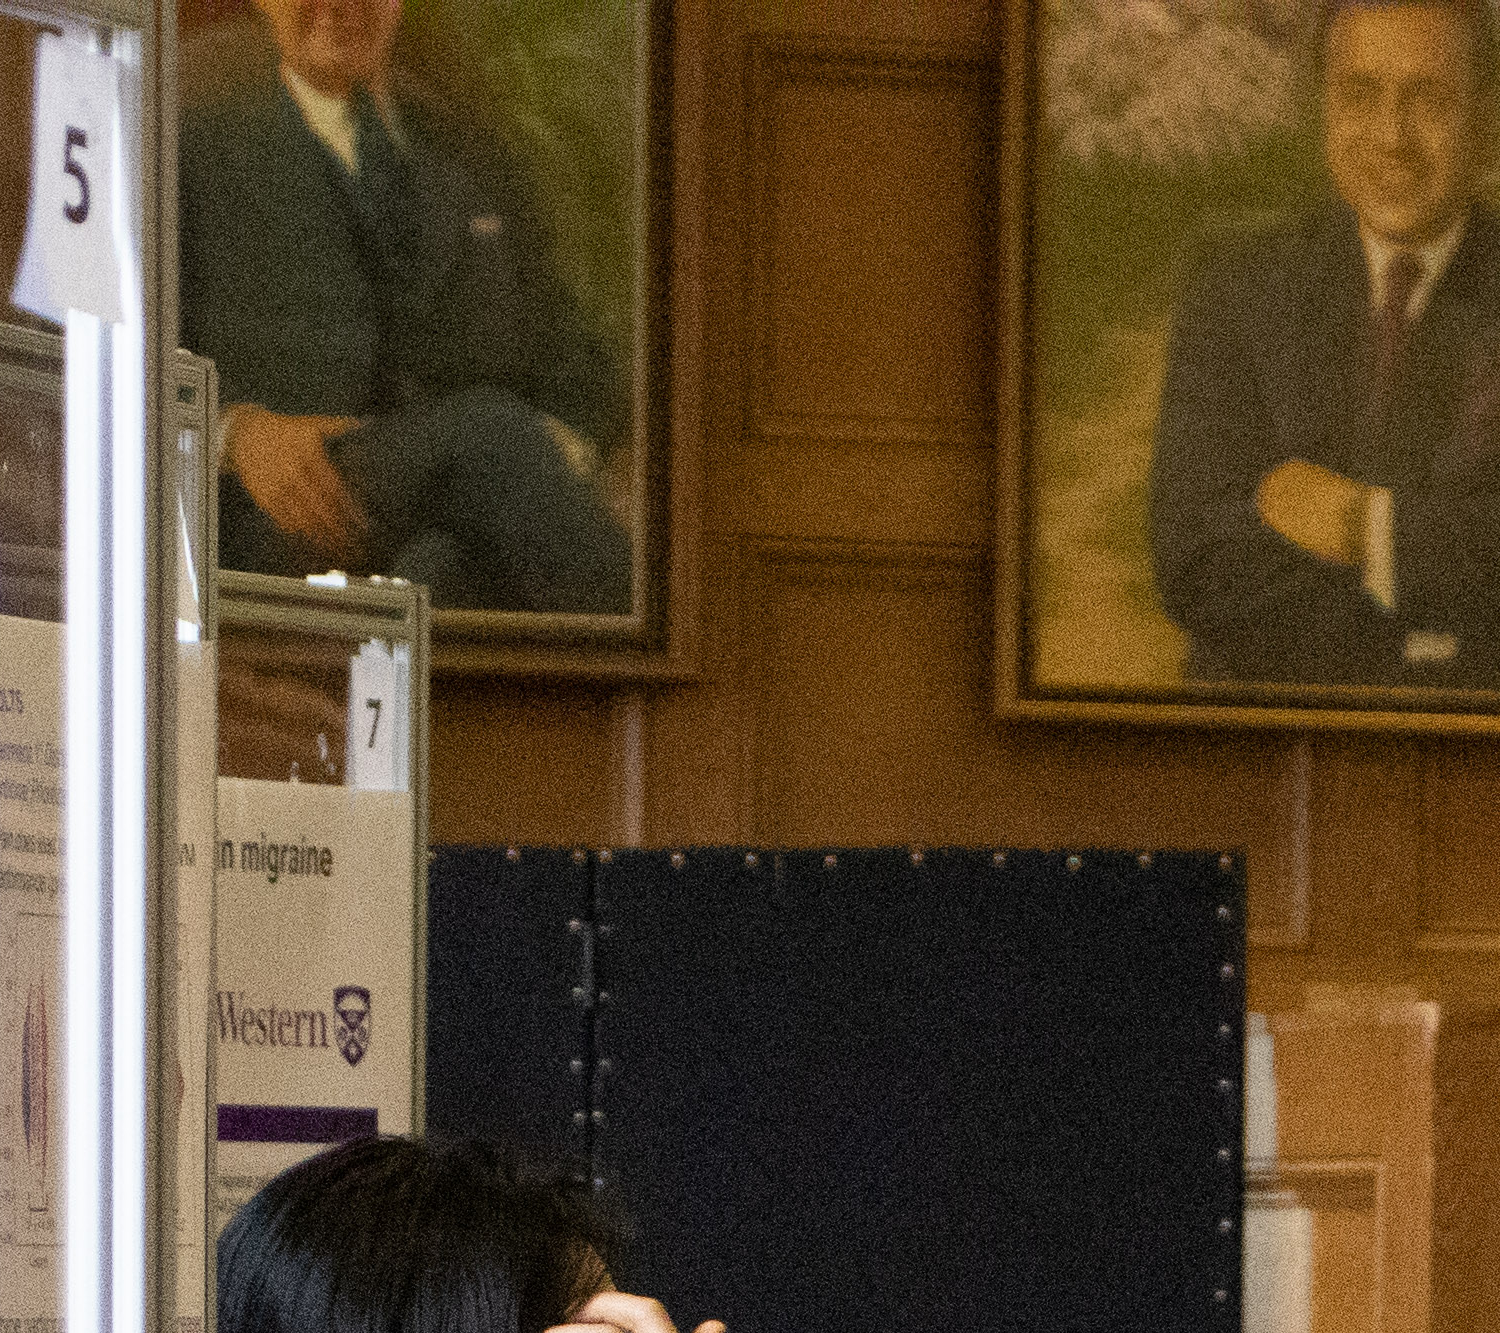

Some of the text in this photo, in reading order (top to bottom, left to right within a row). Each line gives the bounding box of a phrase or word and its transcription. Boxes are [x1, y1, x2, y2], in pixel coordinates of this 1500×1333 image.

[63, 125, 91, 224] 5
[364, 698, 383, 749] 7
[240, 831, 334, 883] migraine
[216, 991, 328, 1049] Western
